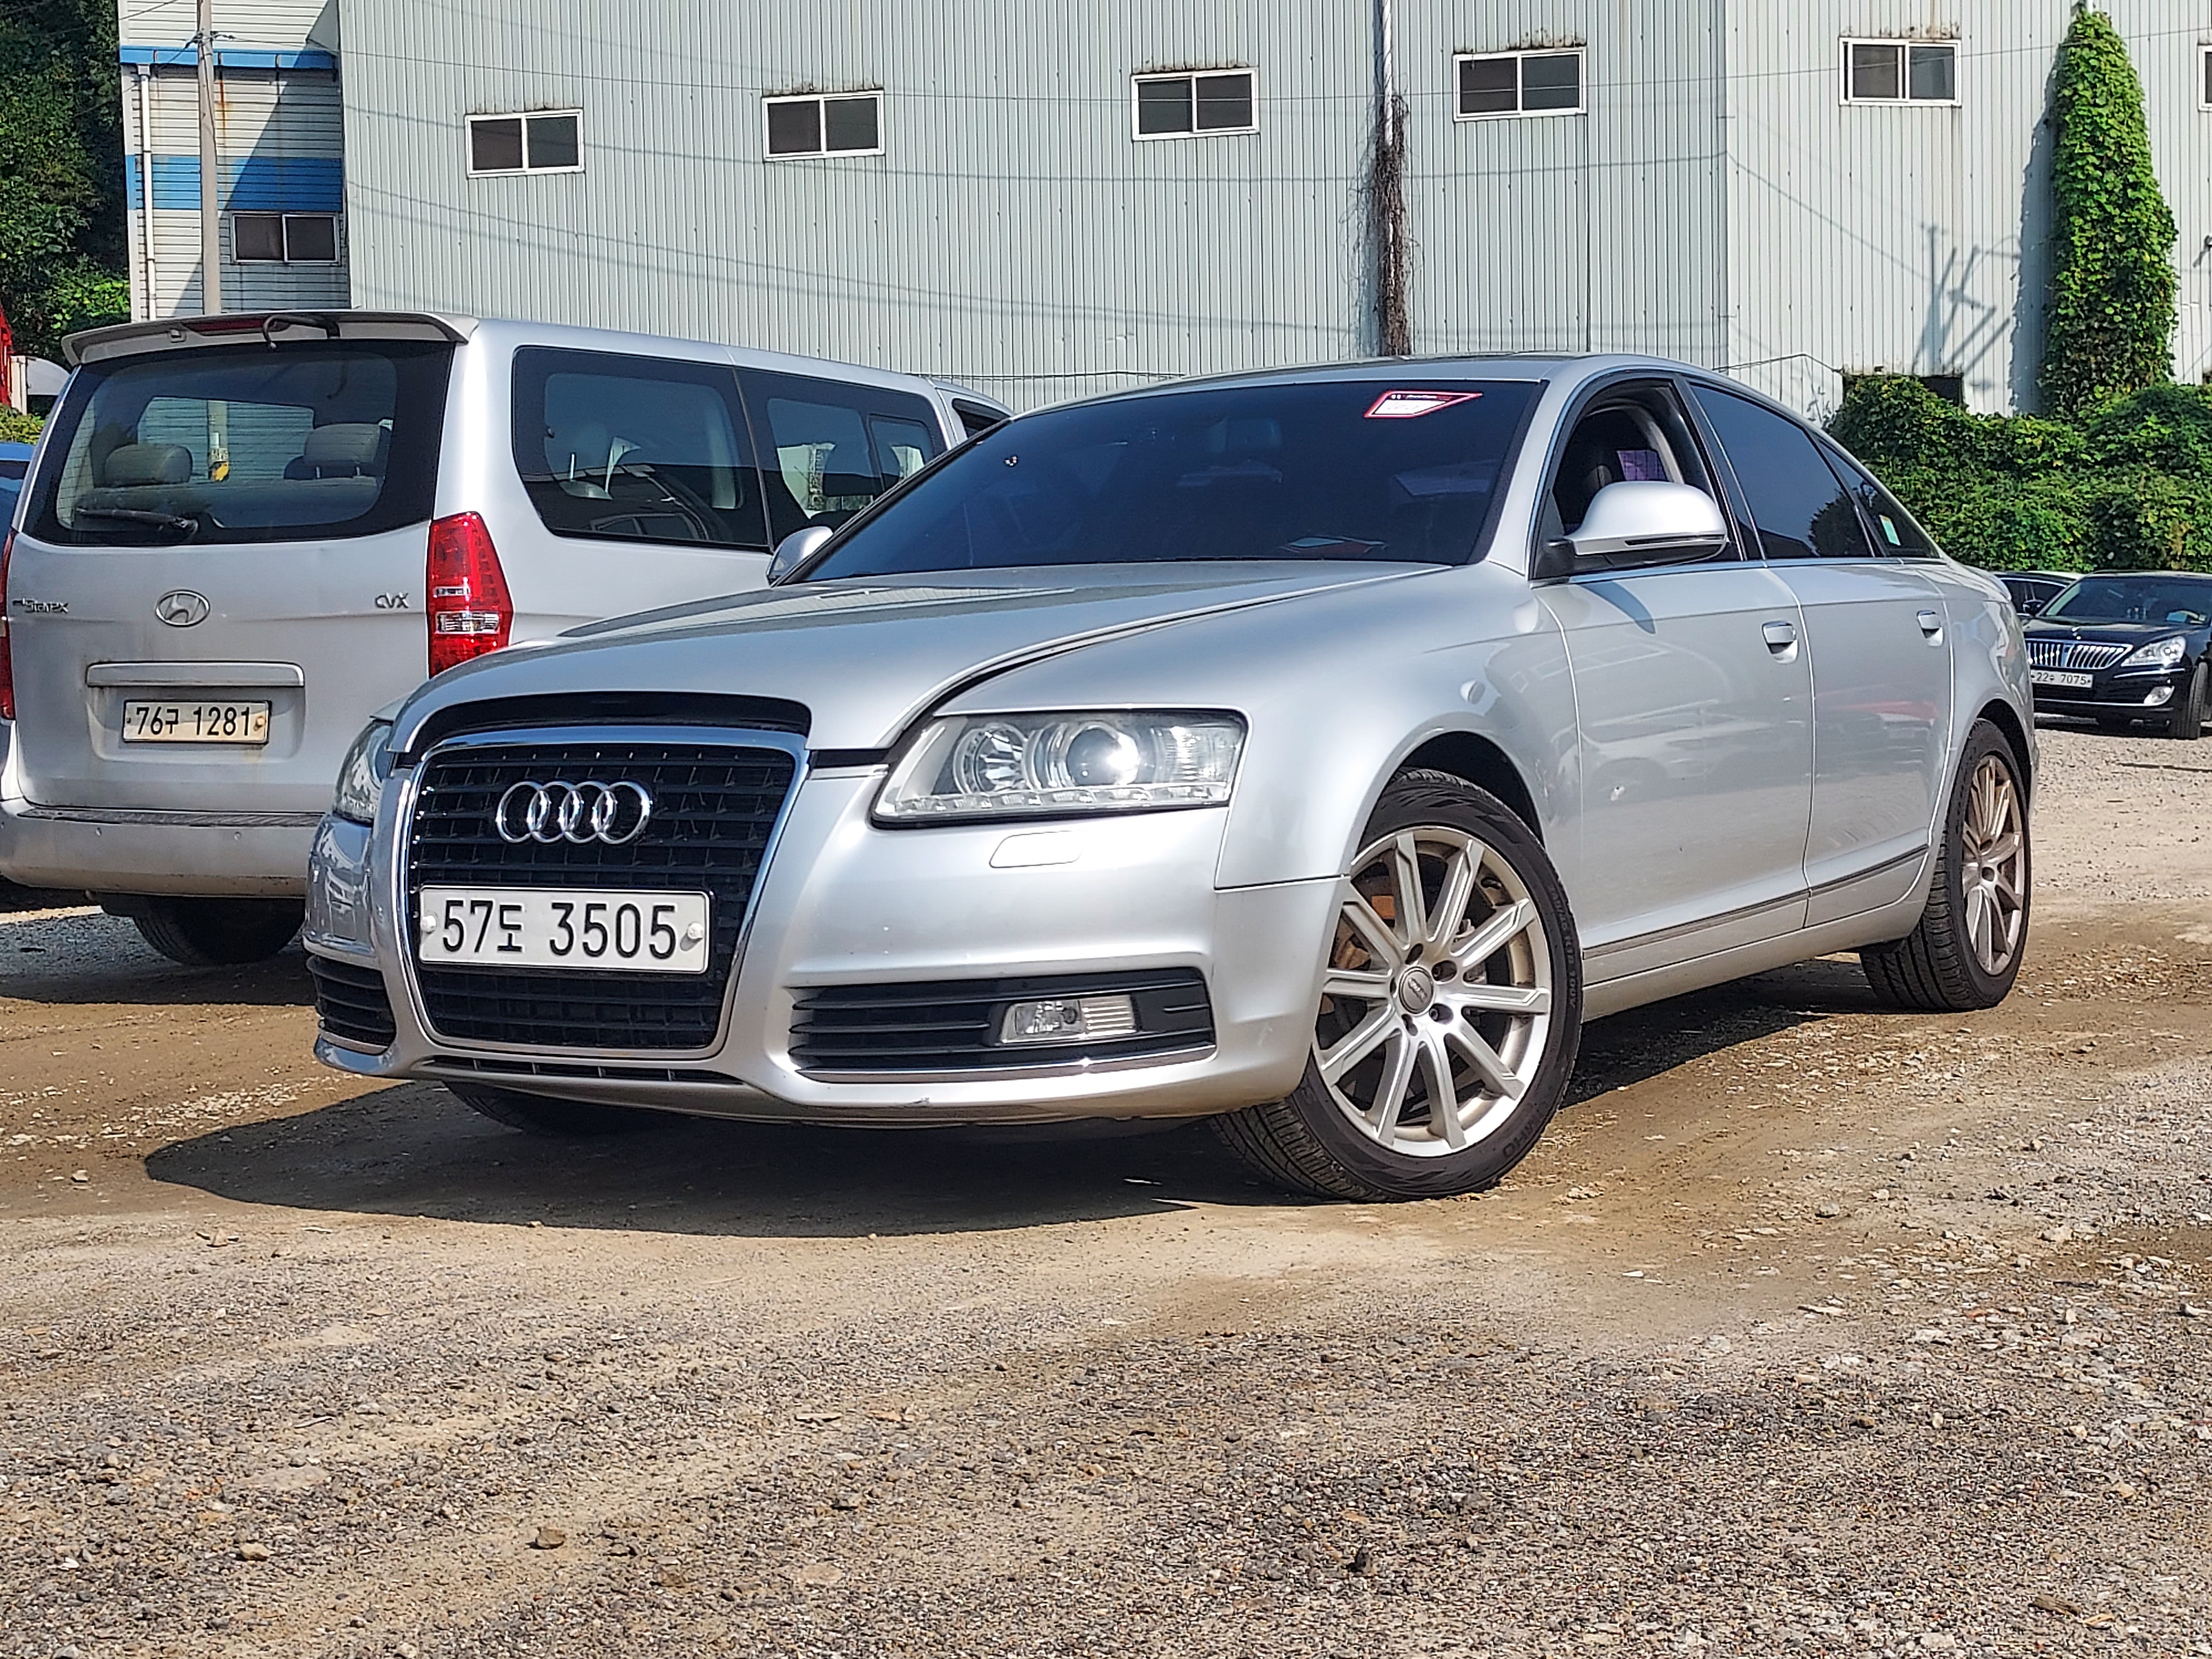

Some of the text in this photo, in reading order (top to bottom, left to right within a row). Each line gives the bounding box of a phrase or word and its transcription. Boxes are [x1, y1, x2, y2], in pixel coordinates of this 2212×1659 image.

[375, 592, 409, 609] CVX
[2061, 674, 2086, 685] 7075
[136, 706, 250, 736] 76구 1281
[442, 900, 676, 959] 57도 3505
